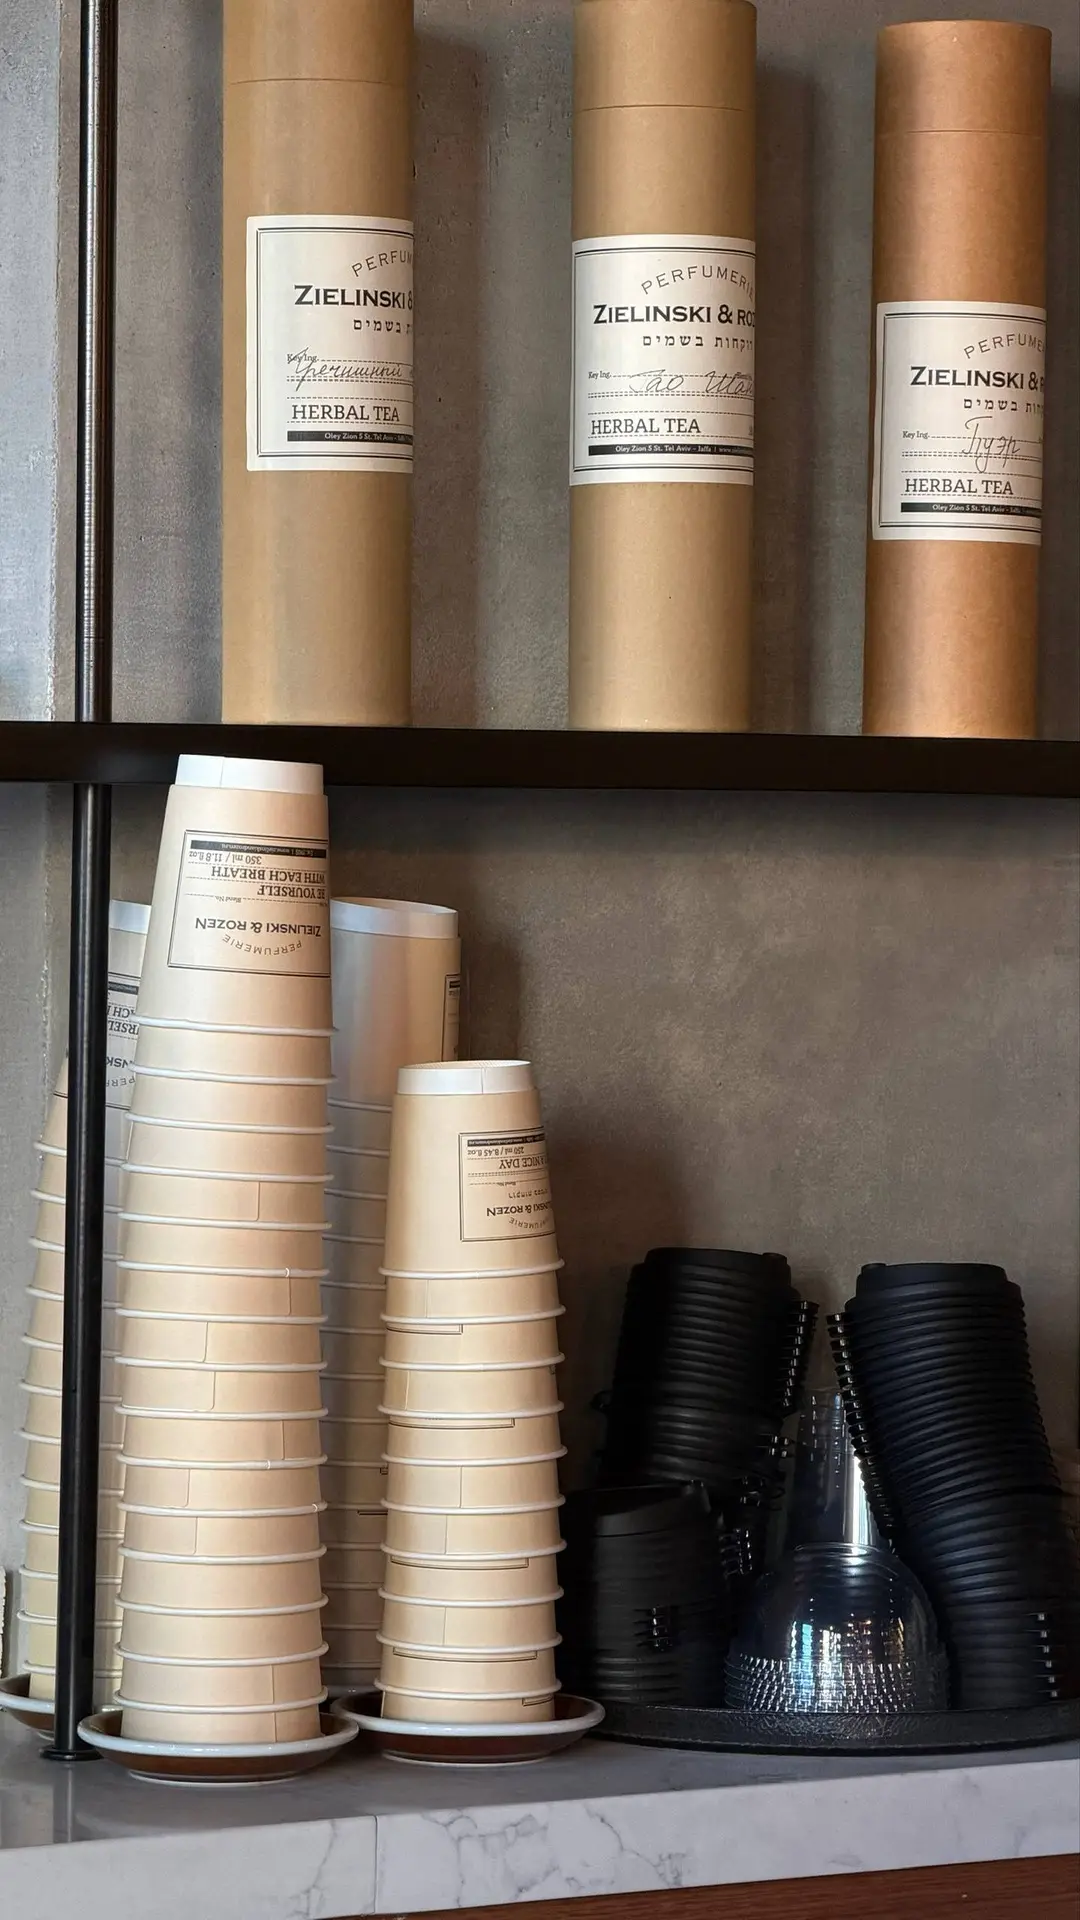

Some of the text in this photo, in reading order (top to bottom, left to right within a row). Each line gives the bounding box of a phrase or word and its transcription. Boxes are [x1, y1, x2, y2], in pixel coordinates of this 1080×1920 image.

[351, 250, 413, 277] PERFUM
[294, 284, 405, 309] ZIELINSKI
[593, 304, 711, 324] ZIELINSKI
[717, 304, 733, 324] &
[353, 318, 402, 334] בשמים
[642, 335, 704, 348] בשמים
[963, 333, 1045, 359] PERFUME
[588, 371, 612, 380] Key Ing.
[910, 366, 1024, 389] ZIELINSKI
[1028, 371, 1039, 391] &
[963, 398, 1018, 412] בשמים
[292, 404, 400, 422] HERBAL TEA
[591, 418, 701, 435] HERBAL TEA
[342, 432, 358, 440] Zion
[902, 430, 930, 439] Key Ing.
[905, 478, 1014, 495] HERBAL TEA
[932, 503, 948, 511] Oley
[206, 853, 223, 862] 11.8
[232, 854, 243, 863] ml
[245, 855, 262, 864] 350
[211, 866, 325, 883] WITH EACH BREATH
[257, 885, 316, 899] YOURSELF
[195, 918, 321, 937] ZIELINSKI & ROZEN
[221, 934, 302, 957] PERFUMERIE
[484, 1148, 499, 1156] 8.45
[514, 1146, 524, 1154] 250
[499, 1159, 520, 1169] DAY
[522, 1157, 540, 1167] NICE
[487, 1205, 523, 1216] ROZEN
[525, 1205, 531, 1213] &
